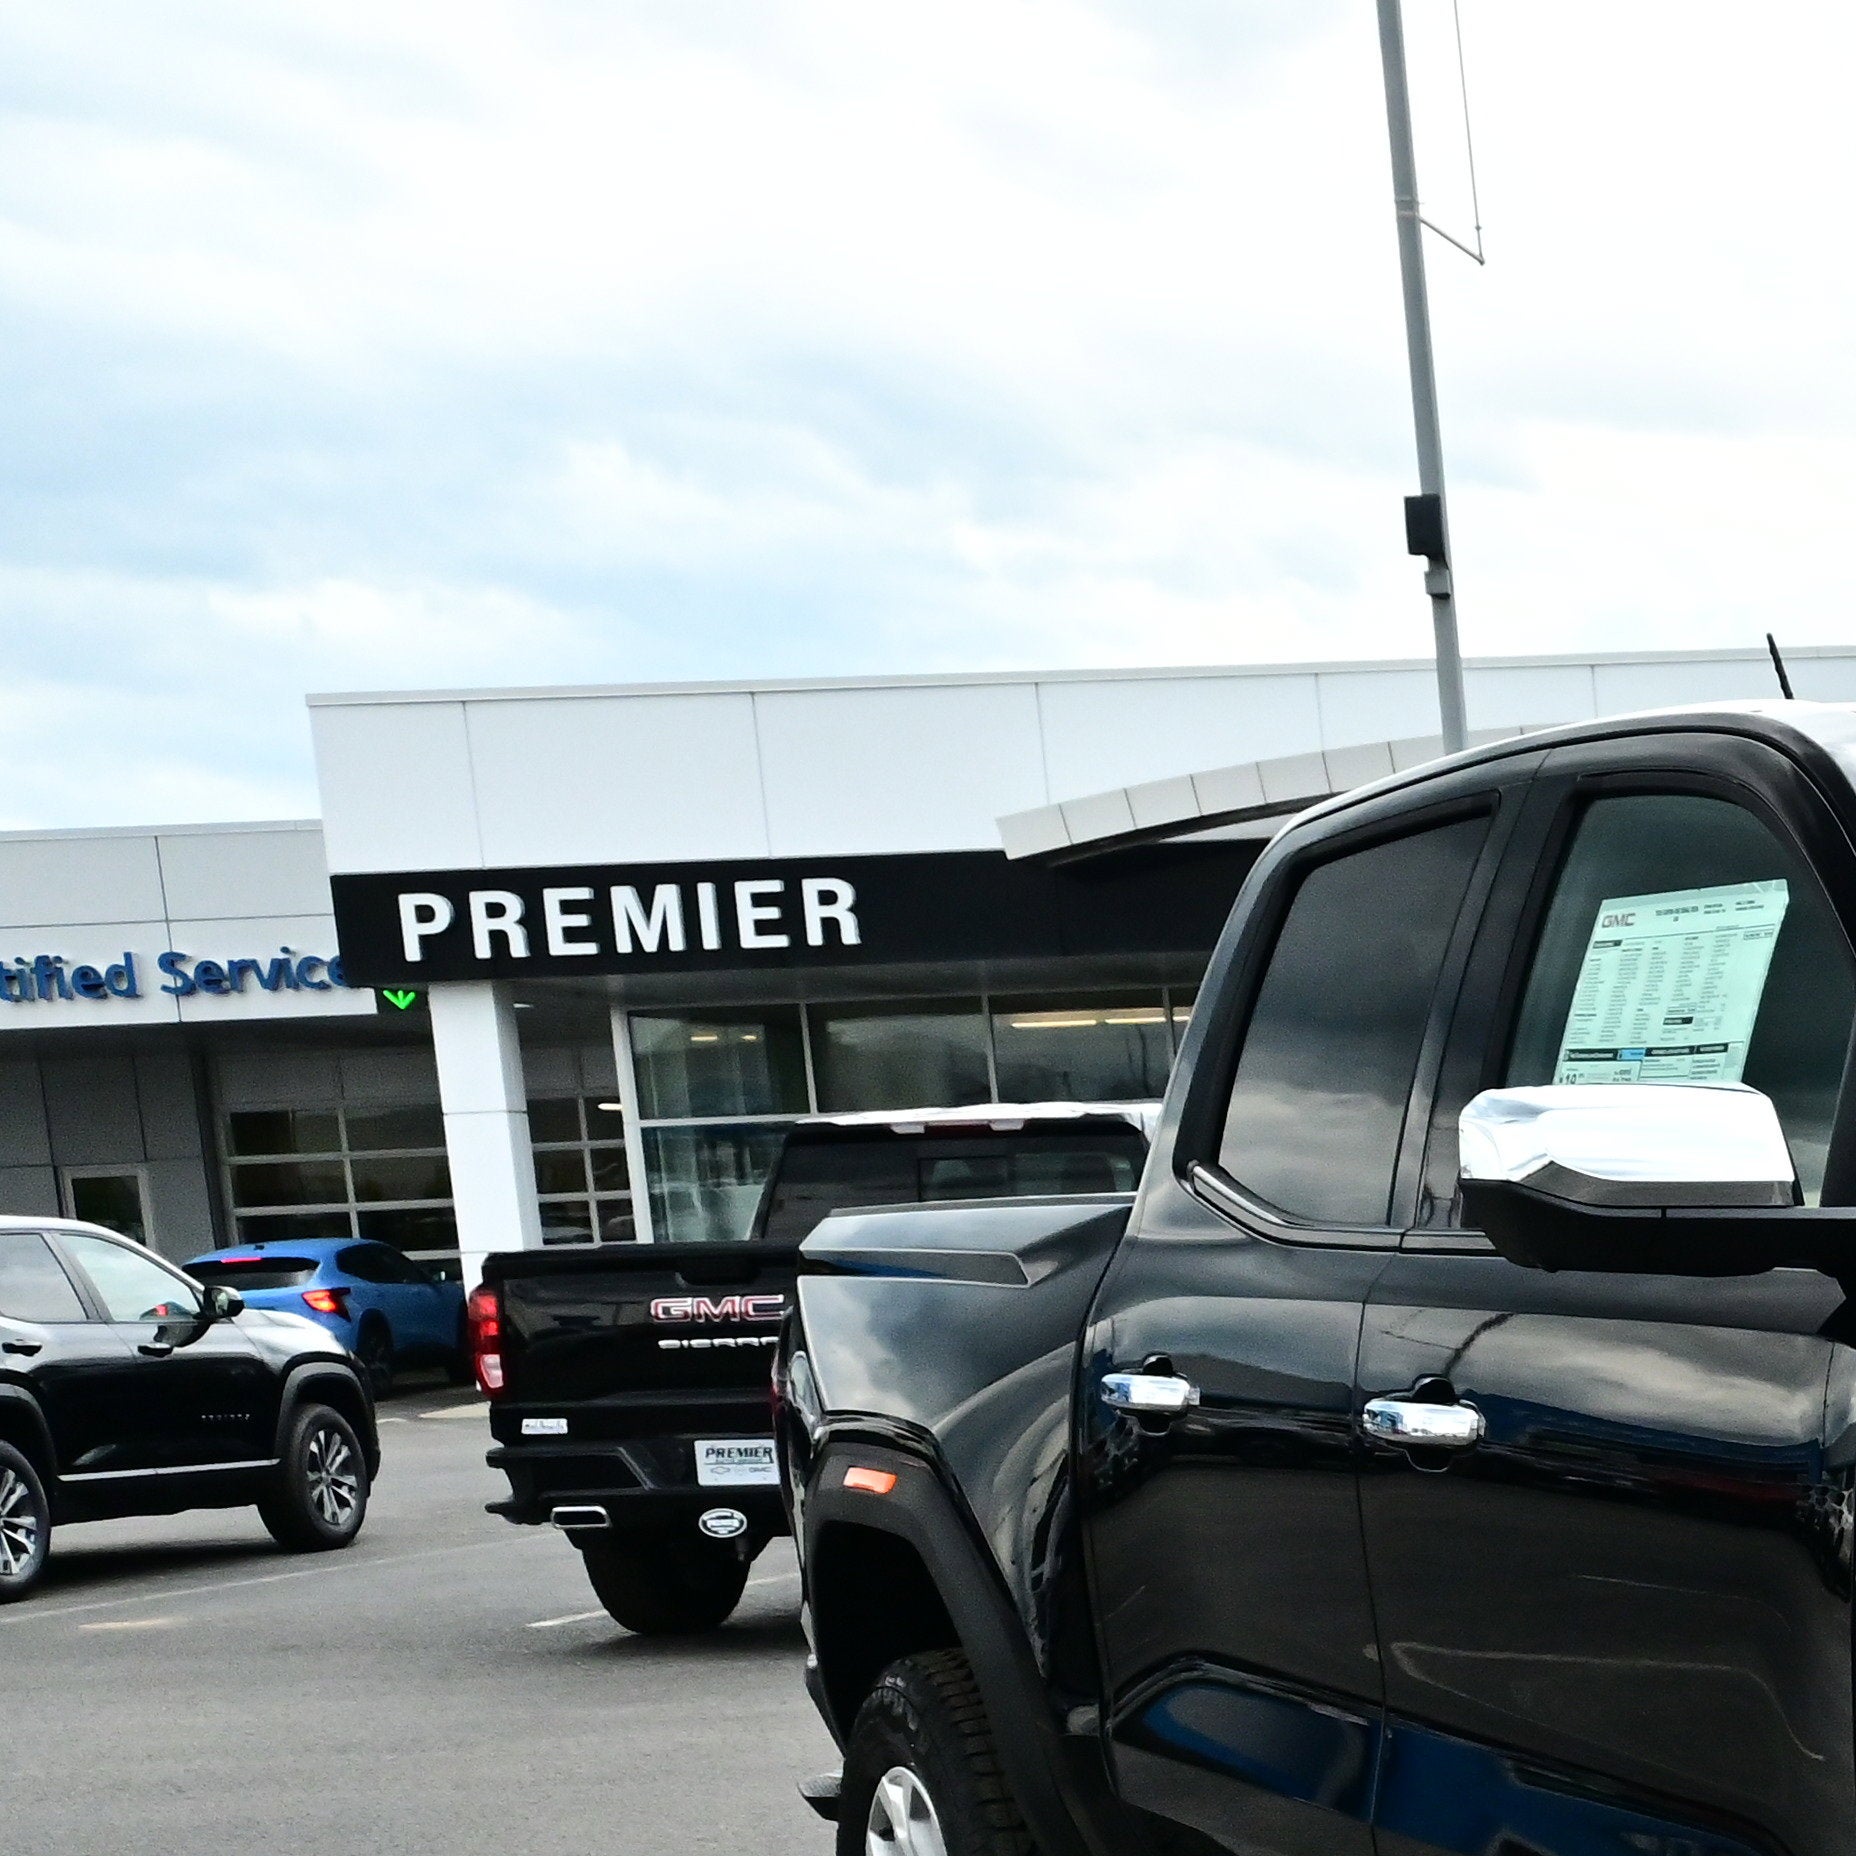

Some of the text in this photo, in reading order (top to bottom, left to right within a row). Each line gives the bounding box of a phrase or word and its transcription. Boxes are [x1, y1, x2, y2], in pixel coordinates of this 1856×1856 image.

[398, 876, 862, 962] PREMIER
[650, 1294, 785, 1322] GMC
[705, 1447, 774, 1463] PREMIER
